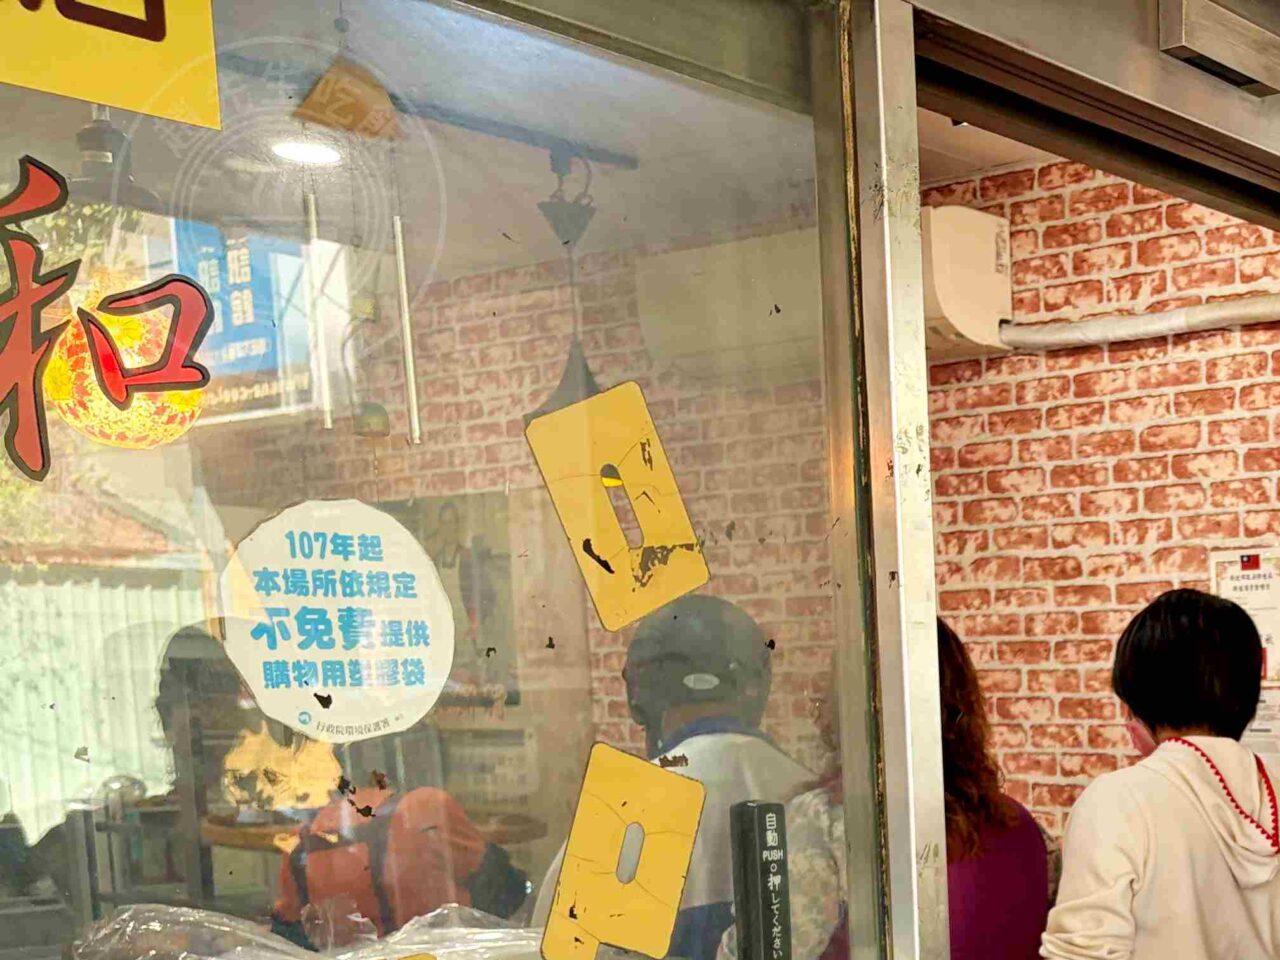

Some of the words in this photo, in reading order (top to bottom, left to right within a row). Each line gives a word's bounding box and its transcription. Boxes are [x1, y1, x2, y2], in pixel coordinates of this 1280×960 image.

[285, 531, 384, 562] 107年起
[252, 567, 418, 599] 本場所依規定
[262, 658, 426, 689] 購物用塑膠袋
[765, 812, 778, 847] 自動
[762, 850, 784, 862] PUSH
[767, 874, 783, 960] 押してください
